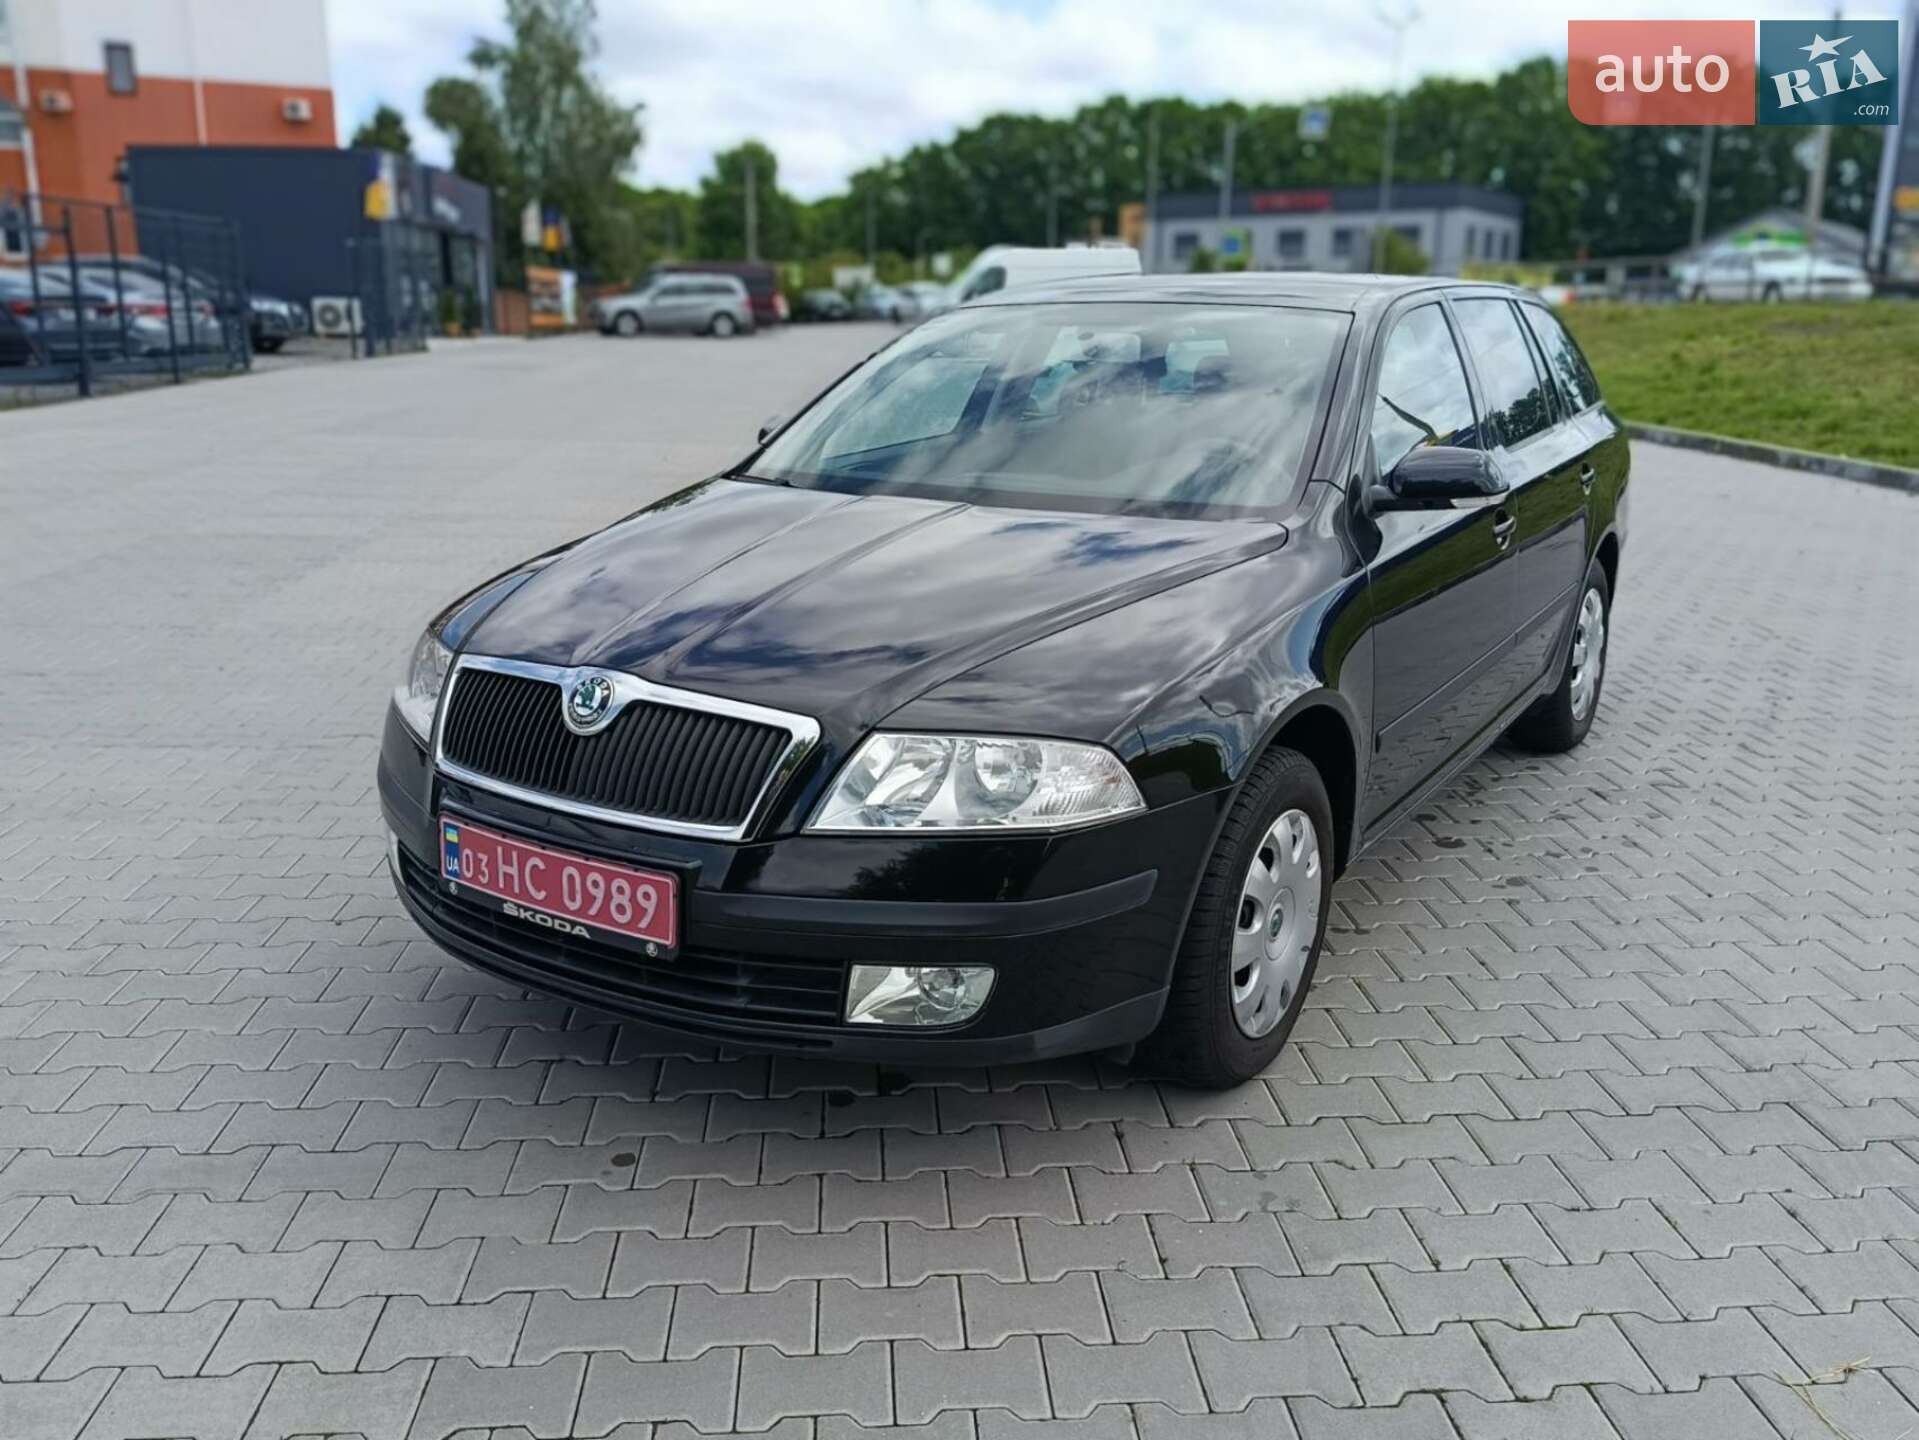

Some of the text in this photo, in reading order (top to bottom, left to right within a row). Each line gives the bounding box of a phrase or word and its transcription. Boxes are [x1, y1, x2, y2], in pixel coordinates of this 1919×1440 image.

[446, 855, 459, 873] UA
[461, 846, 658, 929] 03 HC 0989
